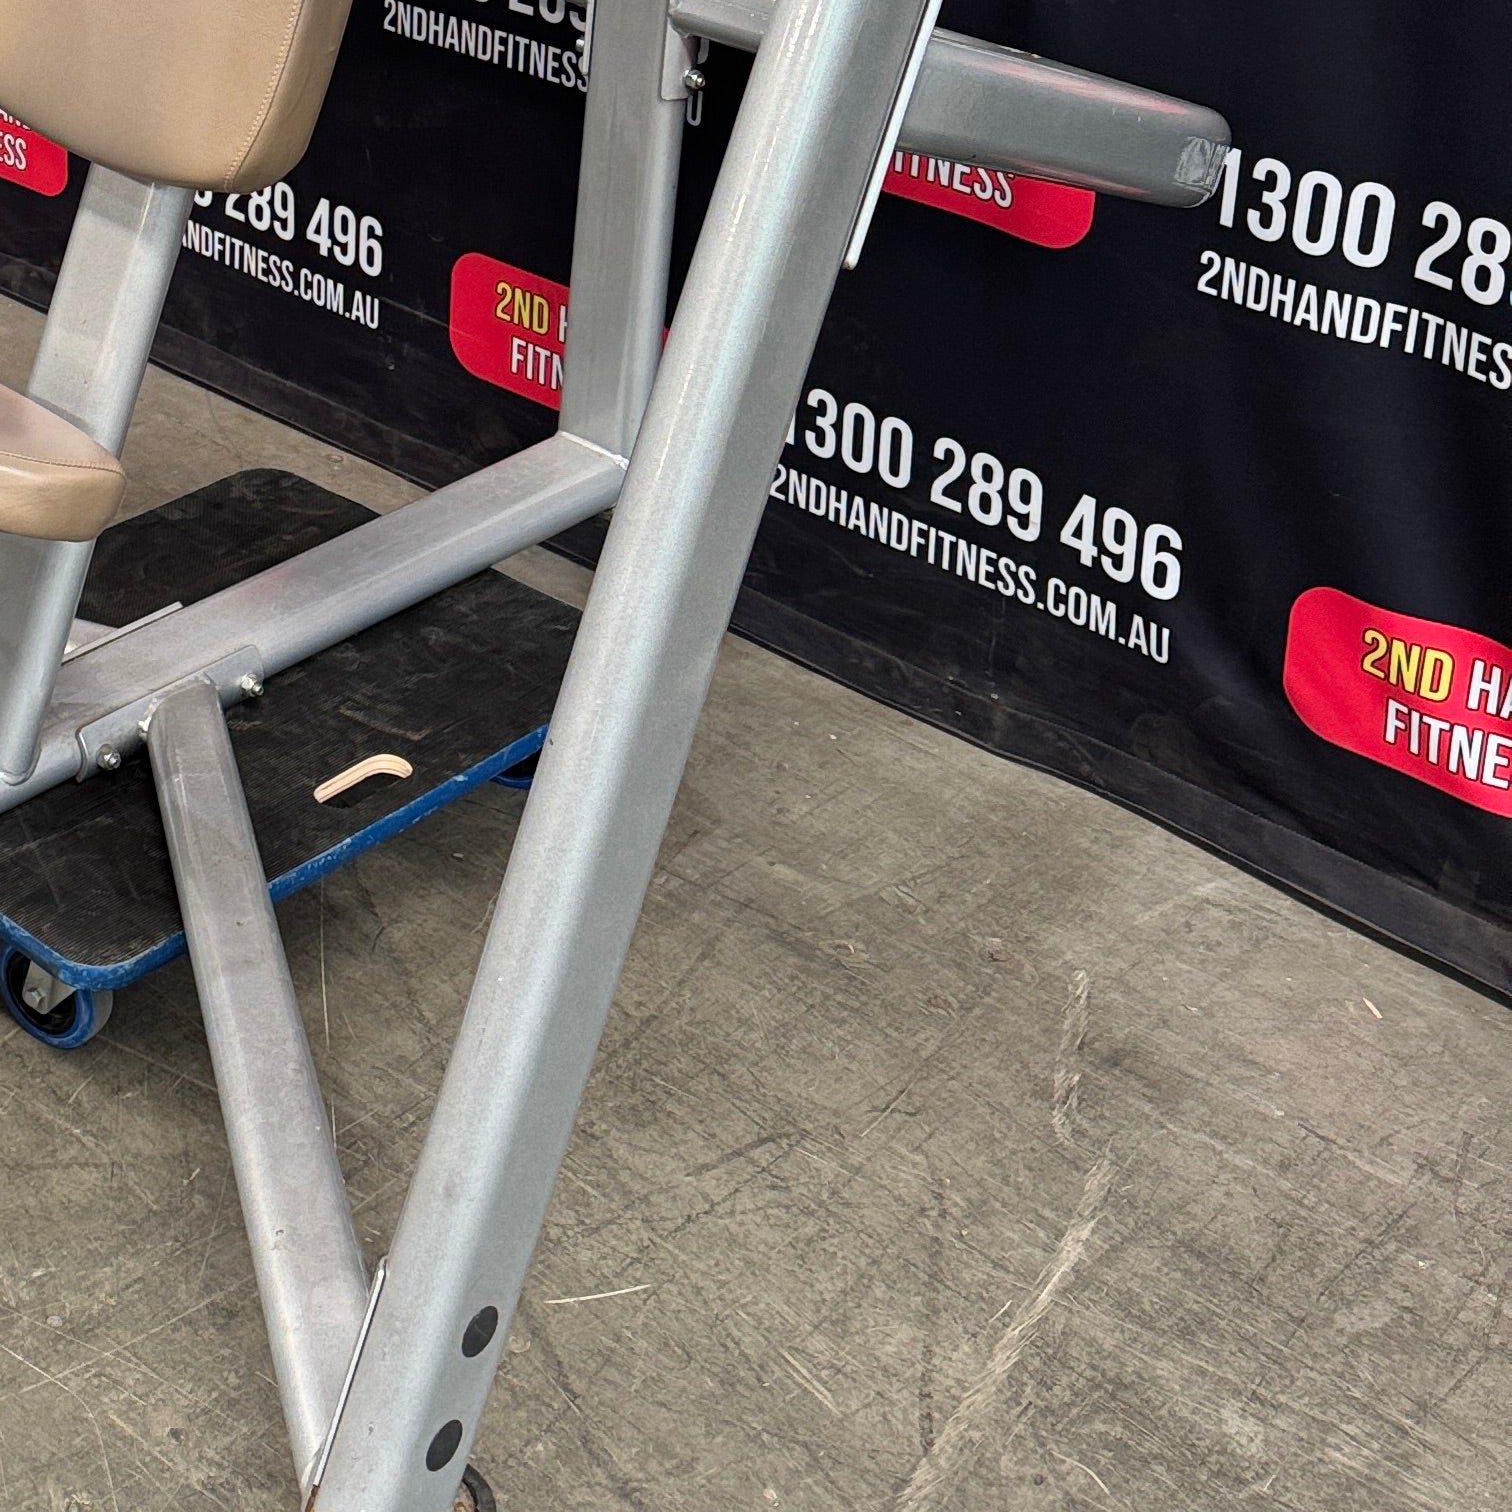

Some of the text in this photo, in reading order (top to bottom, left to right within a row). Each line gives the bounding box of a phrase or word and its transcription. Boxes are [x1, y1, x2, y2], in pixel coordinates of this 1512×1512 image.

[306, 197, 384, 277] 496
[1218, 147, 1397, 269] 1300
[182, 219, 380, 330] NDFITNESS.COM.AU
[496, 281, 549, 335] 2ND
[769, 463, 1171, 665] 2NDHANDFITNESS.COM.AU
[930, 437, 1043, 542] 289
[1060, 494, 1183, 601] 496
[1362, 628, 1454, 702] 2ND
